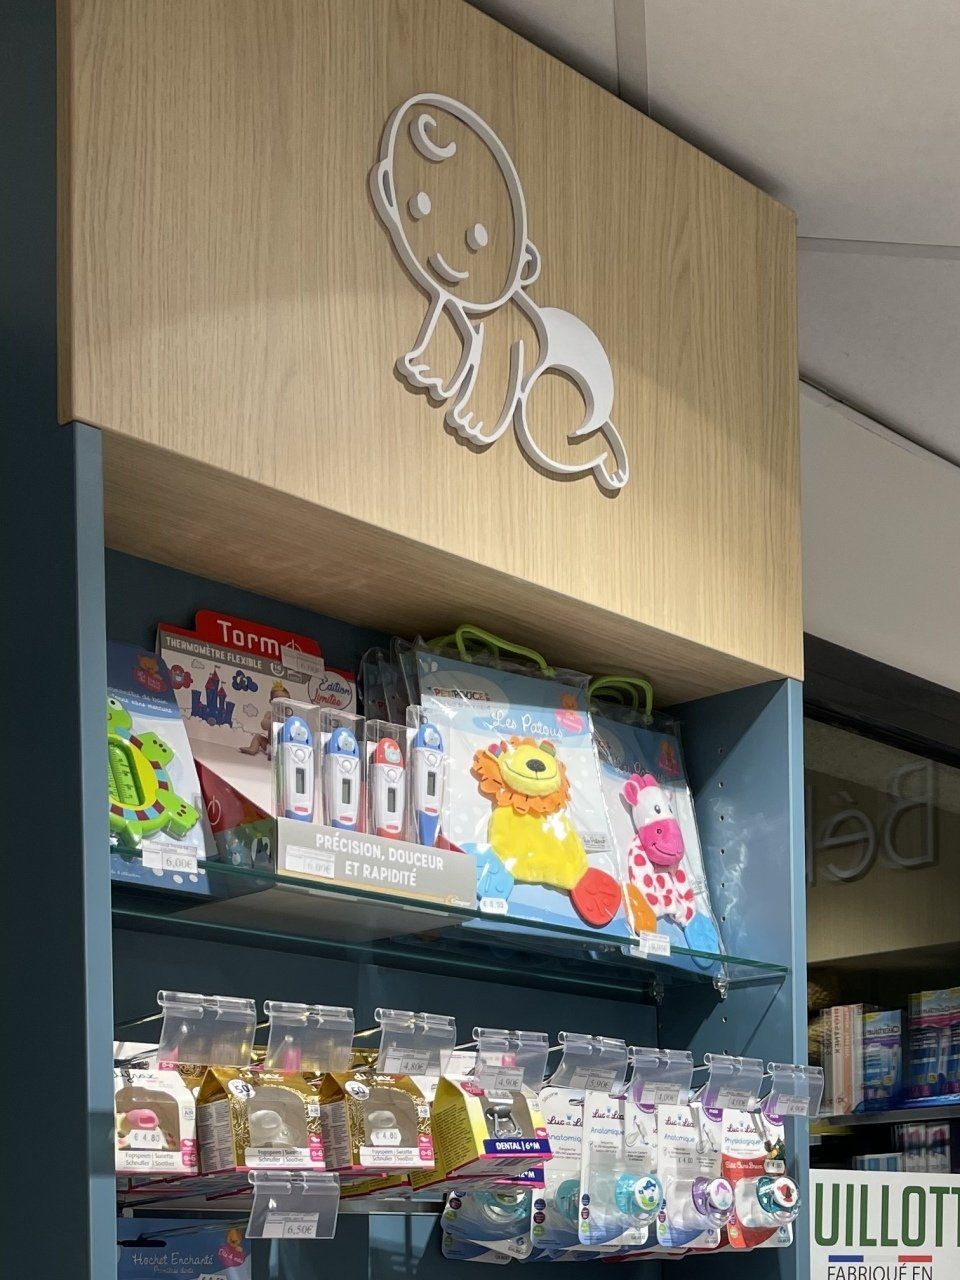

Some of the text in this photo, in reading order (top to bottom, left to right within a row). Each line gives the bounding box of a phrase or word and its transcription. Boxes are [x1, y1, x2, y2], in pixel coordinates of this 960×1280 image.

[165, 636, 262, 670] THERMOMÈTRE FLEXIBLE
[316, 832, 444, 871] PRÉCISION, DOUCEUR
[344, 862, 418, 887] ET RAPIDITÉ
[495, 1141, 521, 1151] DENTAL
